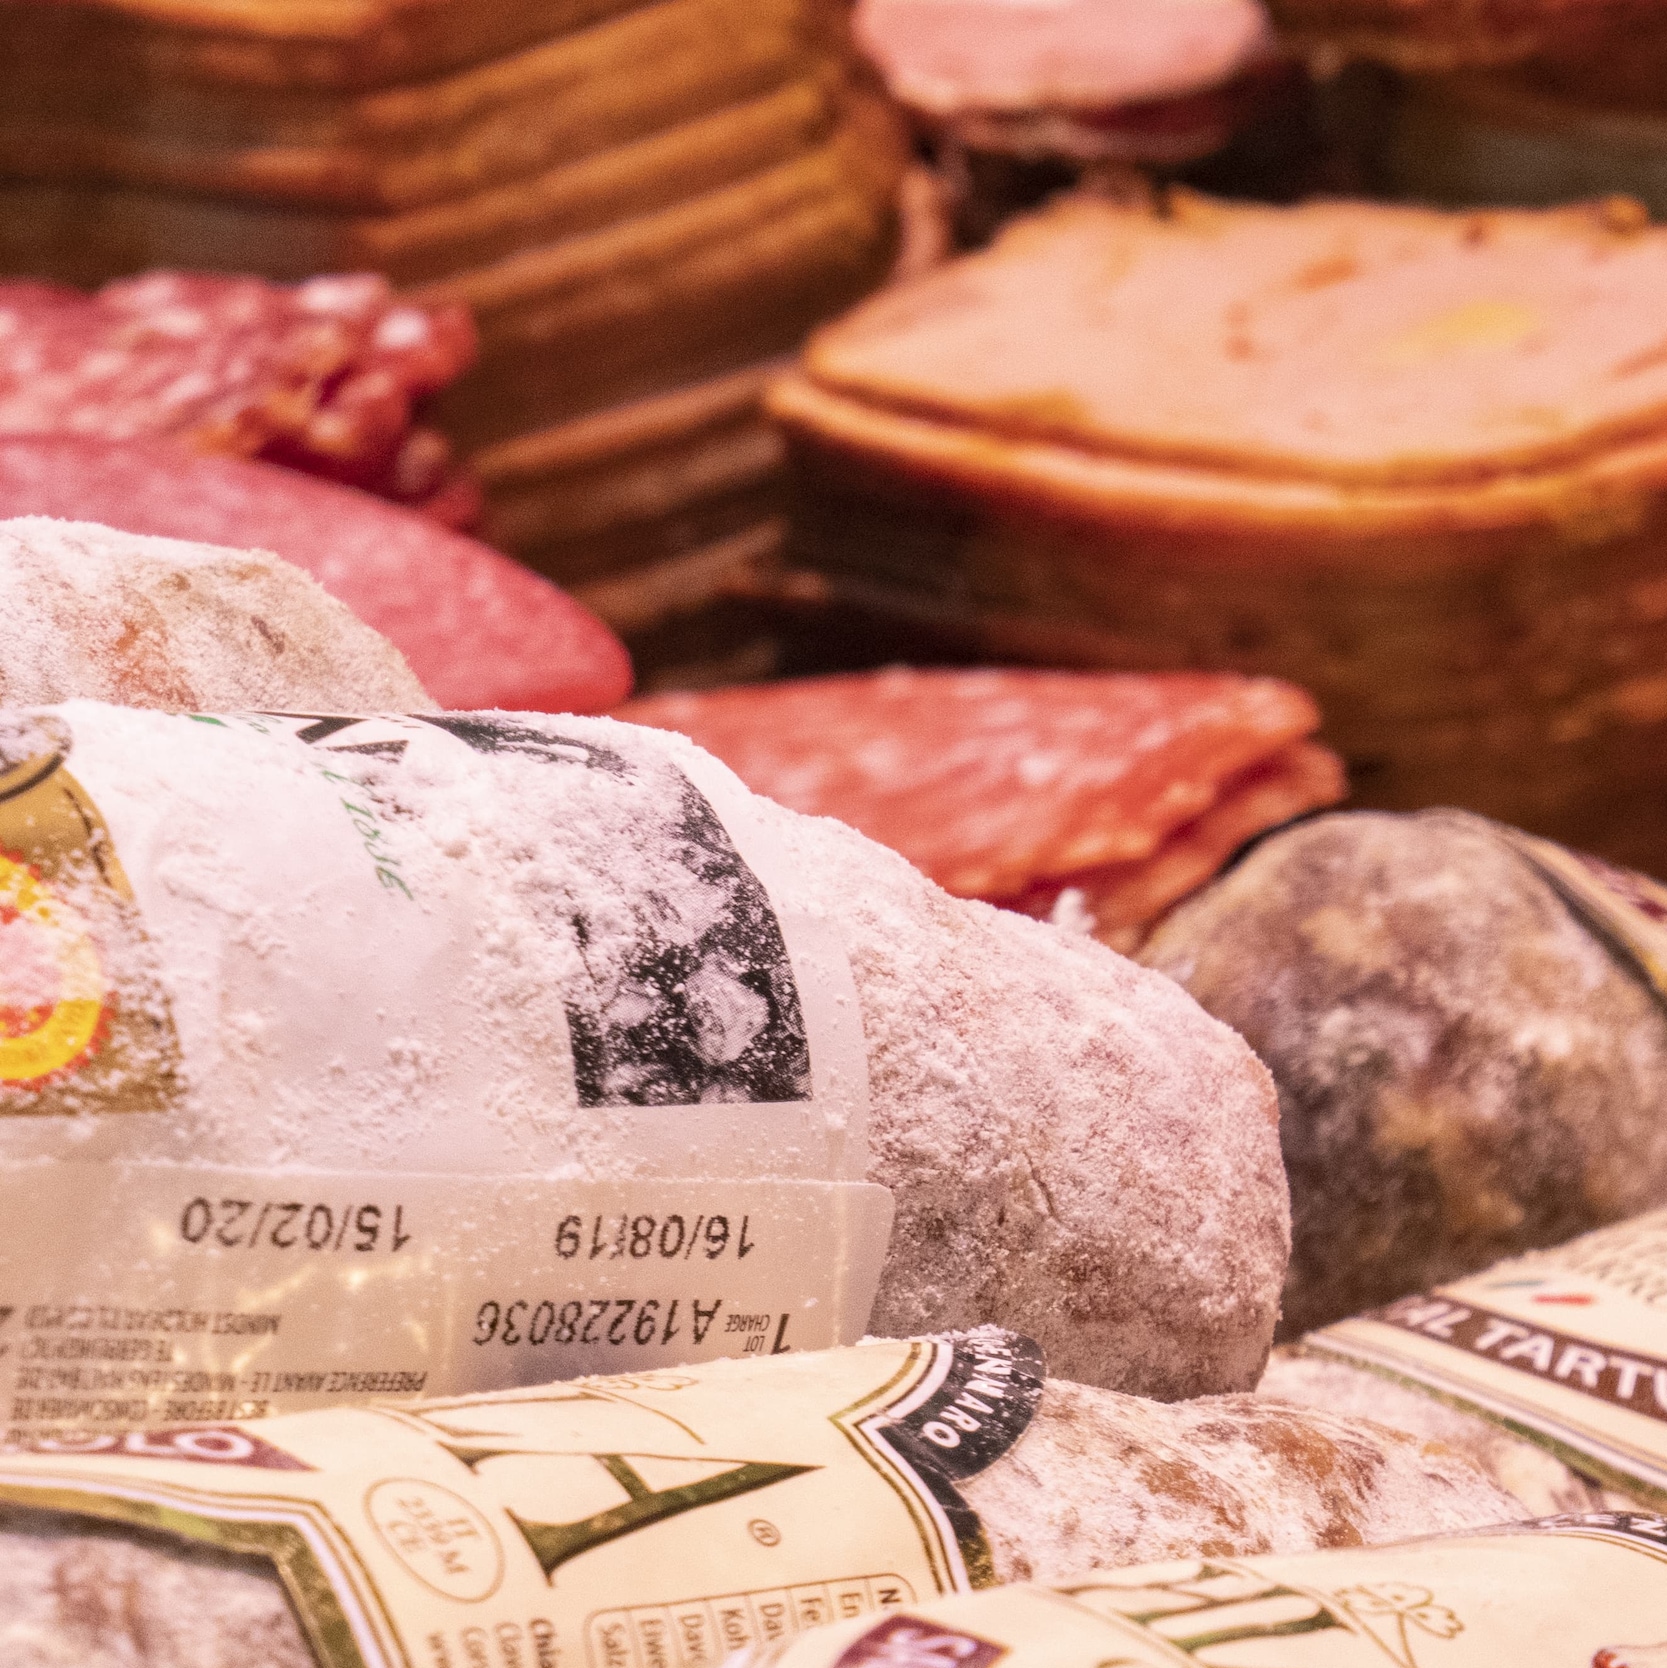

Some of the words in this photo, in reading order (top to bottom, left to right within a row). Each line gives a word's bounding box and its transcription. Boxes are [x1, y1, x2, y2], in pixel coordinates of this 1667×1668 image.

[179, 1197, 411, 1254] 15/02/20
[554, 1213, 756, 1262] 16/08/19
[725, 1312, 771, 1333] CHARGE
[743, 1337, 766, 1353] LOT
